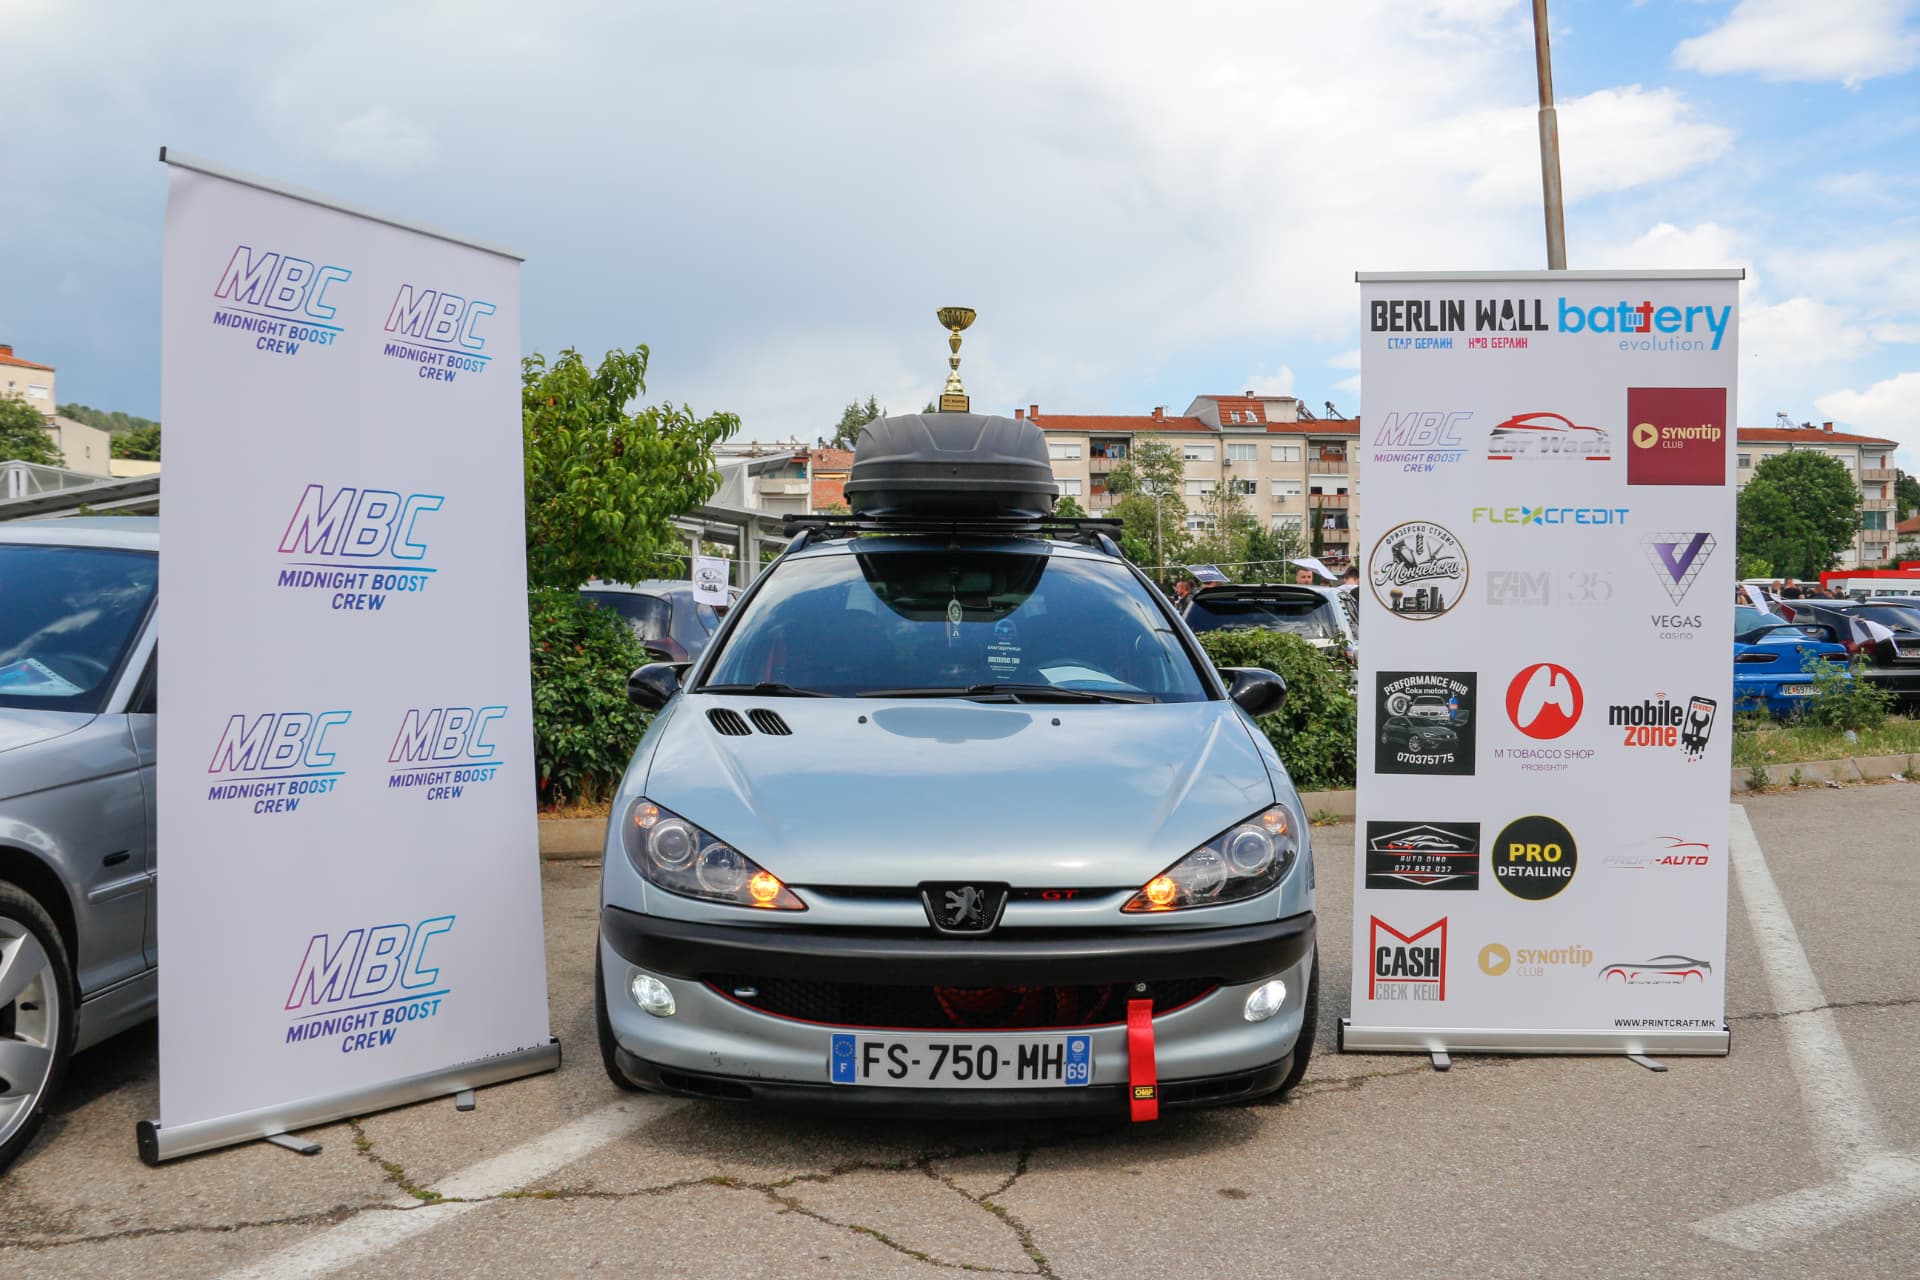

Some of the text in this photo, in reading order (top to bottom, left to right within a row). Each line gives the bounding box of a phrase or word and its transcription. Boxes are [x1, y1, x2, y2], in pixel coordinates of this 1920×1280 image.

[214, 245, 352, 320] MBC
[384, 284, 496, 350] MBC
[1371, 299, 1549, 332] BERLIN WALL
[1558, 297, 1732, 351] battery
[213, 311, 337, 346] MIDNIGHT BOOST
[256, 336, 300, 356] CREW
[1388, 337, 1453, 350] СТАР БЕРЛИН
[1491, 337, 1528, 349] БЕРЛИН
[1619, 335, 1704, 351] evolution
[384, 343, 486, 374] MIDNIGHT BOOST
[418, 366, 457, 383] CREW
[1374, 411, 1474, 447] MBC
[1662, 441, 1684, 449] CLUB
[1373, 453, 1461, 463] MIDNIGHT BOOST
[1403, 464, 1435, 473] CREW
[277, 484, 445, 560] MBC
[1386, 525, 1455, 546] ФРИЗЕРСКО СТУДИО
[277, 570, 429, 593] MIDNIGHT BOOST
[1375, 559, 1460, 586] Мончевски
[331, 593, 386, 611] CREW
[1651, 615, 1702, 628] VEGAS
[1659, 631, 1693, 640] casino
[1384, 675, 1469, 695] PERFORMANCE HUB
[1609, 699, 1684, 726] mobile
[208, 710, 352, 774] MBC
[388, 706, 508, 763] MBC
[1624, 726, 1678, 747] zone
[1397, 752, 1455, 765] 070375775
[1494, 749, 1595, 759] M TOBACCO SHOP
[388, 768, 497, 788] MIDNIGHT BOOST
[208, 779, 337, 801] MIDNIGHT BOOST
[427, 786, 464, 801] CREW
[253, 798, 300, 815] CREW
[1400, 855, 1422, 863] AUTO
[1509, 843, 1562, 863] PRO
[1498, 866, 1572, 877] DETAILING
[1041, 889, 1080, 900] GT
[285, 915, 456, 1011] MBC
[1376, 946, 1440, 977] CASH
[1516, 967, 1544, 977] CLUB
[1375, 983, 1440, 1001] СВЕЖ КЕШ
[286, 999, 442, 1043] MIDNIGHT BOOST
[1614, 1019, 1716, 1027] WWW.PRINTCRAFT.MK
[342, 1027, 397, 1053] CREW
[840, 1063, 848, 1073] F
[863, 1042, 1064, 1081] FS-750-MH
[1067, 1062, 1087, 1080] 69
[1135, 1088, 1154, 1096] OMP
